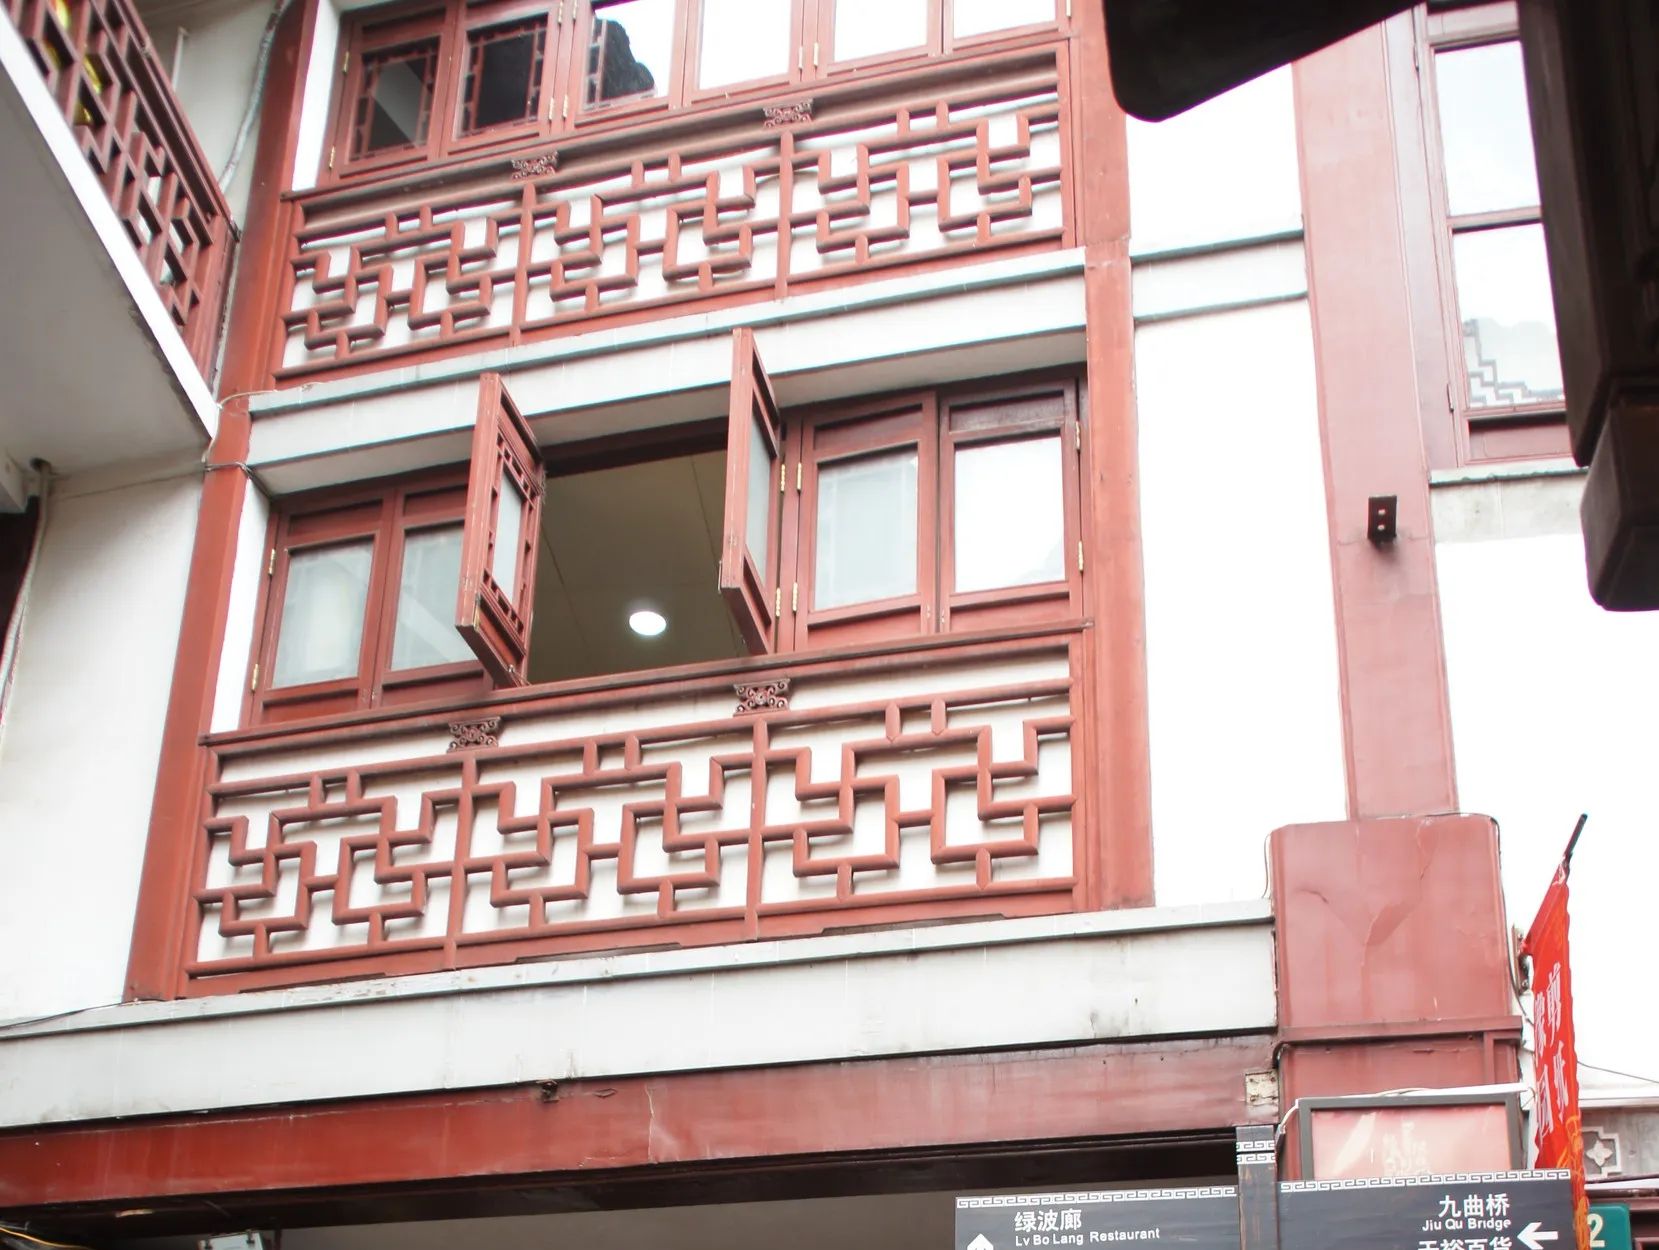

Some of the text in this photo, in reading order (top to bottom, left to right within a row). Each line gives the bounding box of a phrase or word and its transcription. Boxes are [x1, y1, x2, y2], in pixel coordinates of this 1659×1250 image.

[1439, 1193, 1510, 1218] 九曲桥
[1014, 1209, 1082, 1231] 绿波廊
[1422, 1218, 1511, 1231] Jiu Qu Bridge
[1016, 1228, 1160, 1246] Lv Bo Lang Restaurant
